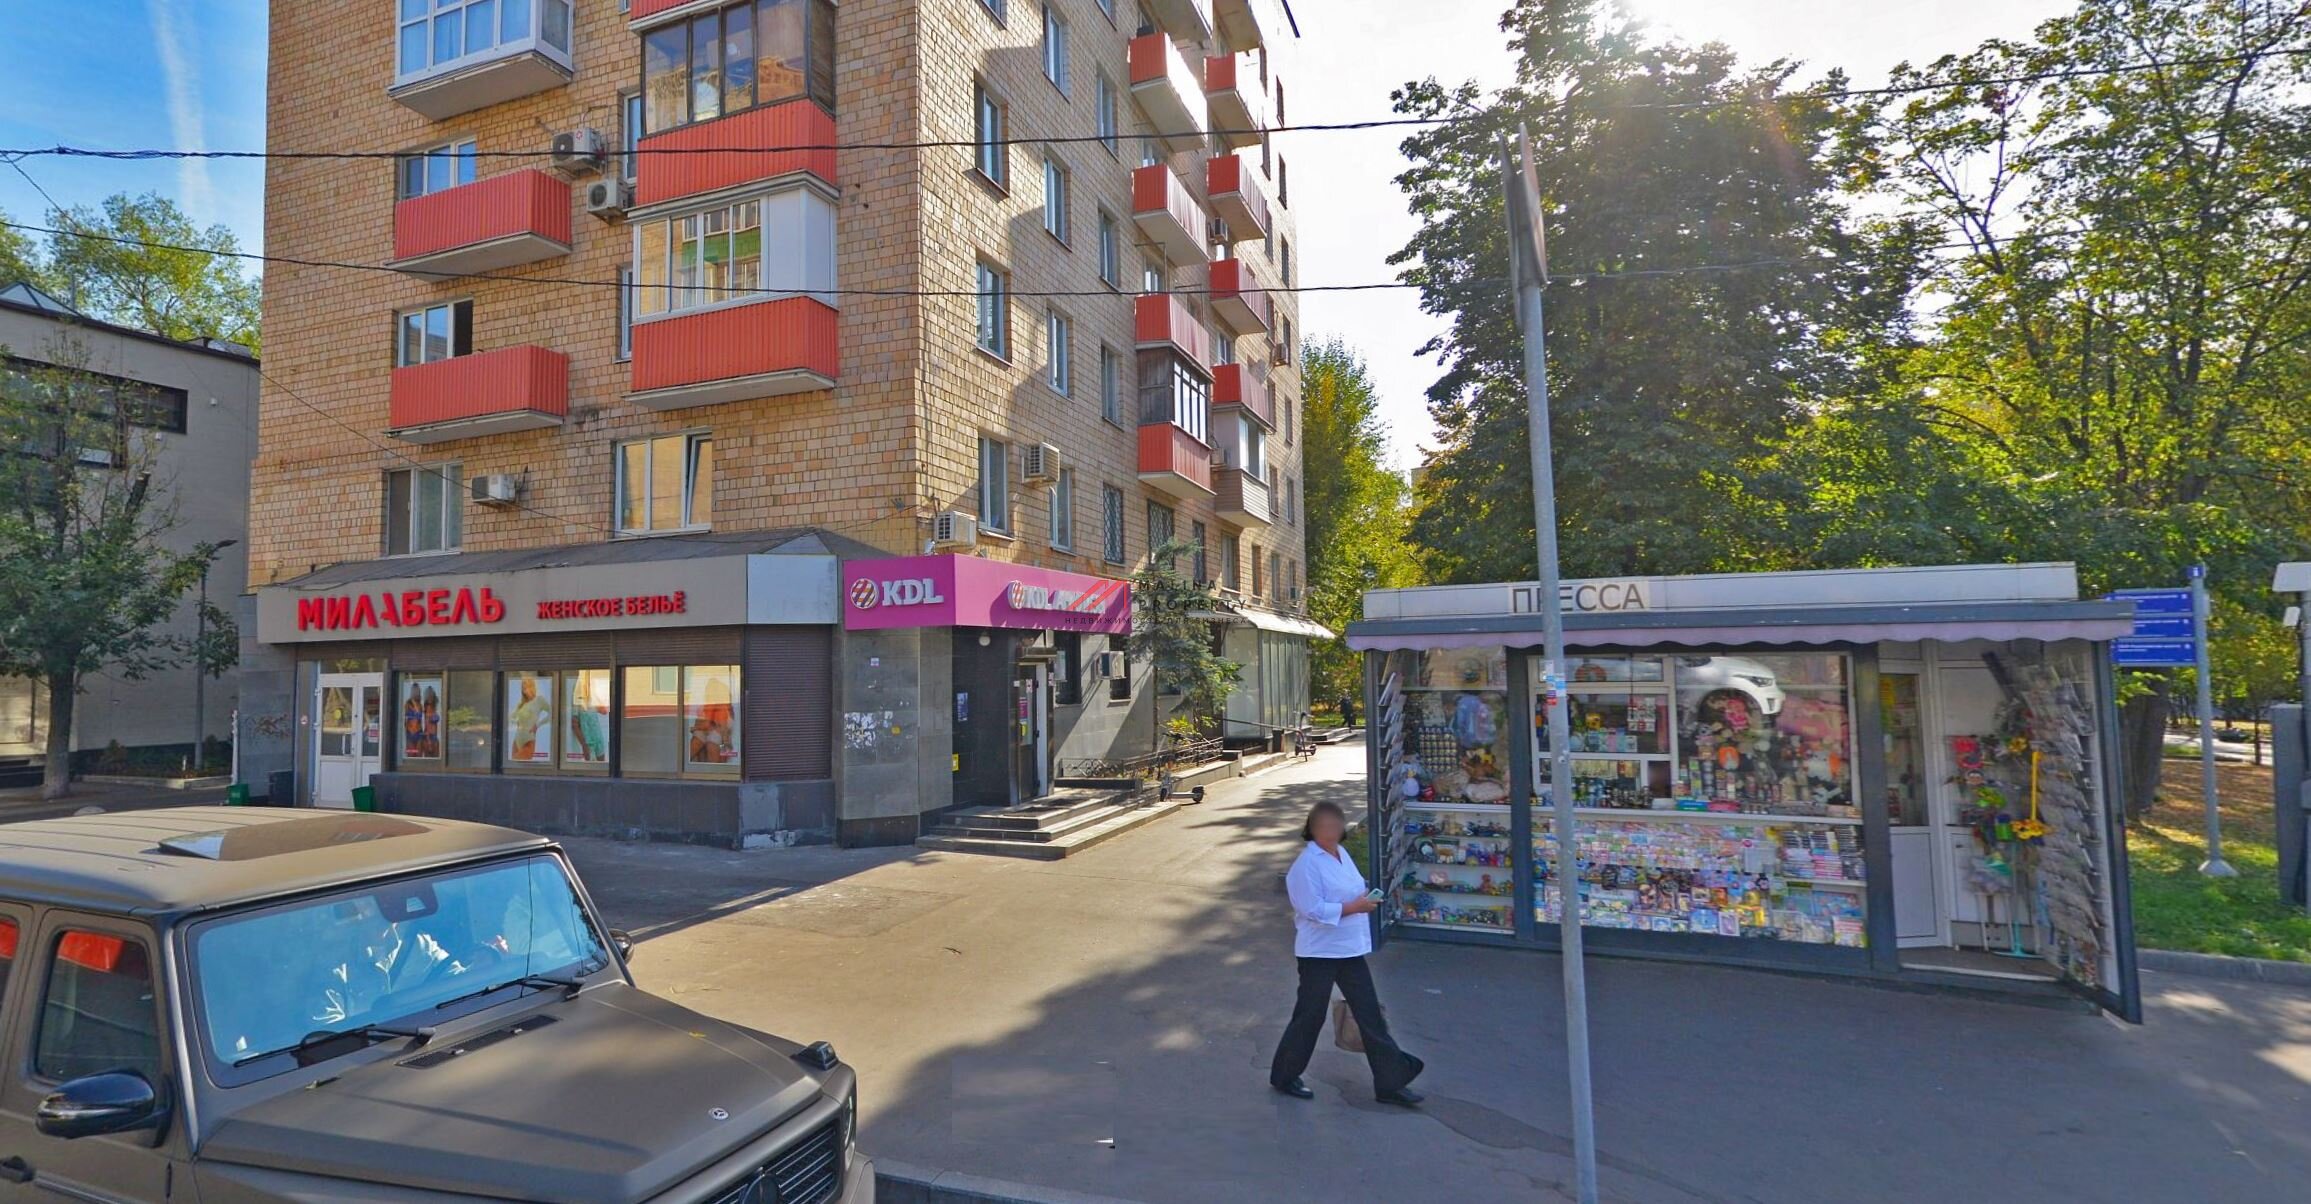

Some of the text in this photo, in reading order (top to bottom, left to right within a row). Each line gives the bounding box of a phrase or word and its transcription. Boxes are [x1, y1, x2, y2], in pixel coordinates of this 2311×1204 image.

[536, 590, 686, 620] ЖЕНСКОЕ БЕЛЬЁ
[881, 578, 944, 607] KDL
[1512, 583, 1645, 614] ПЕССА
[298, 586, 505, 631] МИЛАБЕЛЬ
